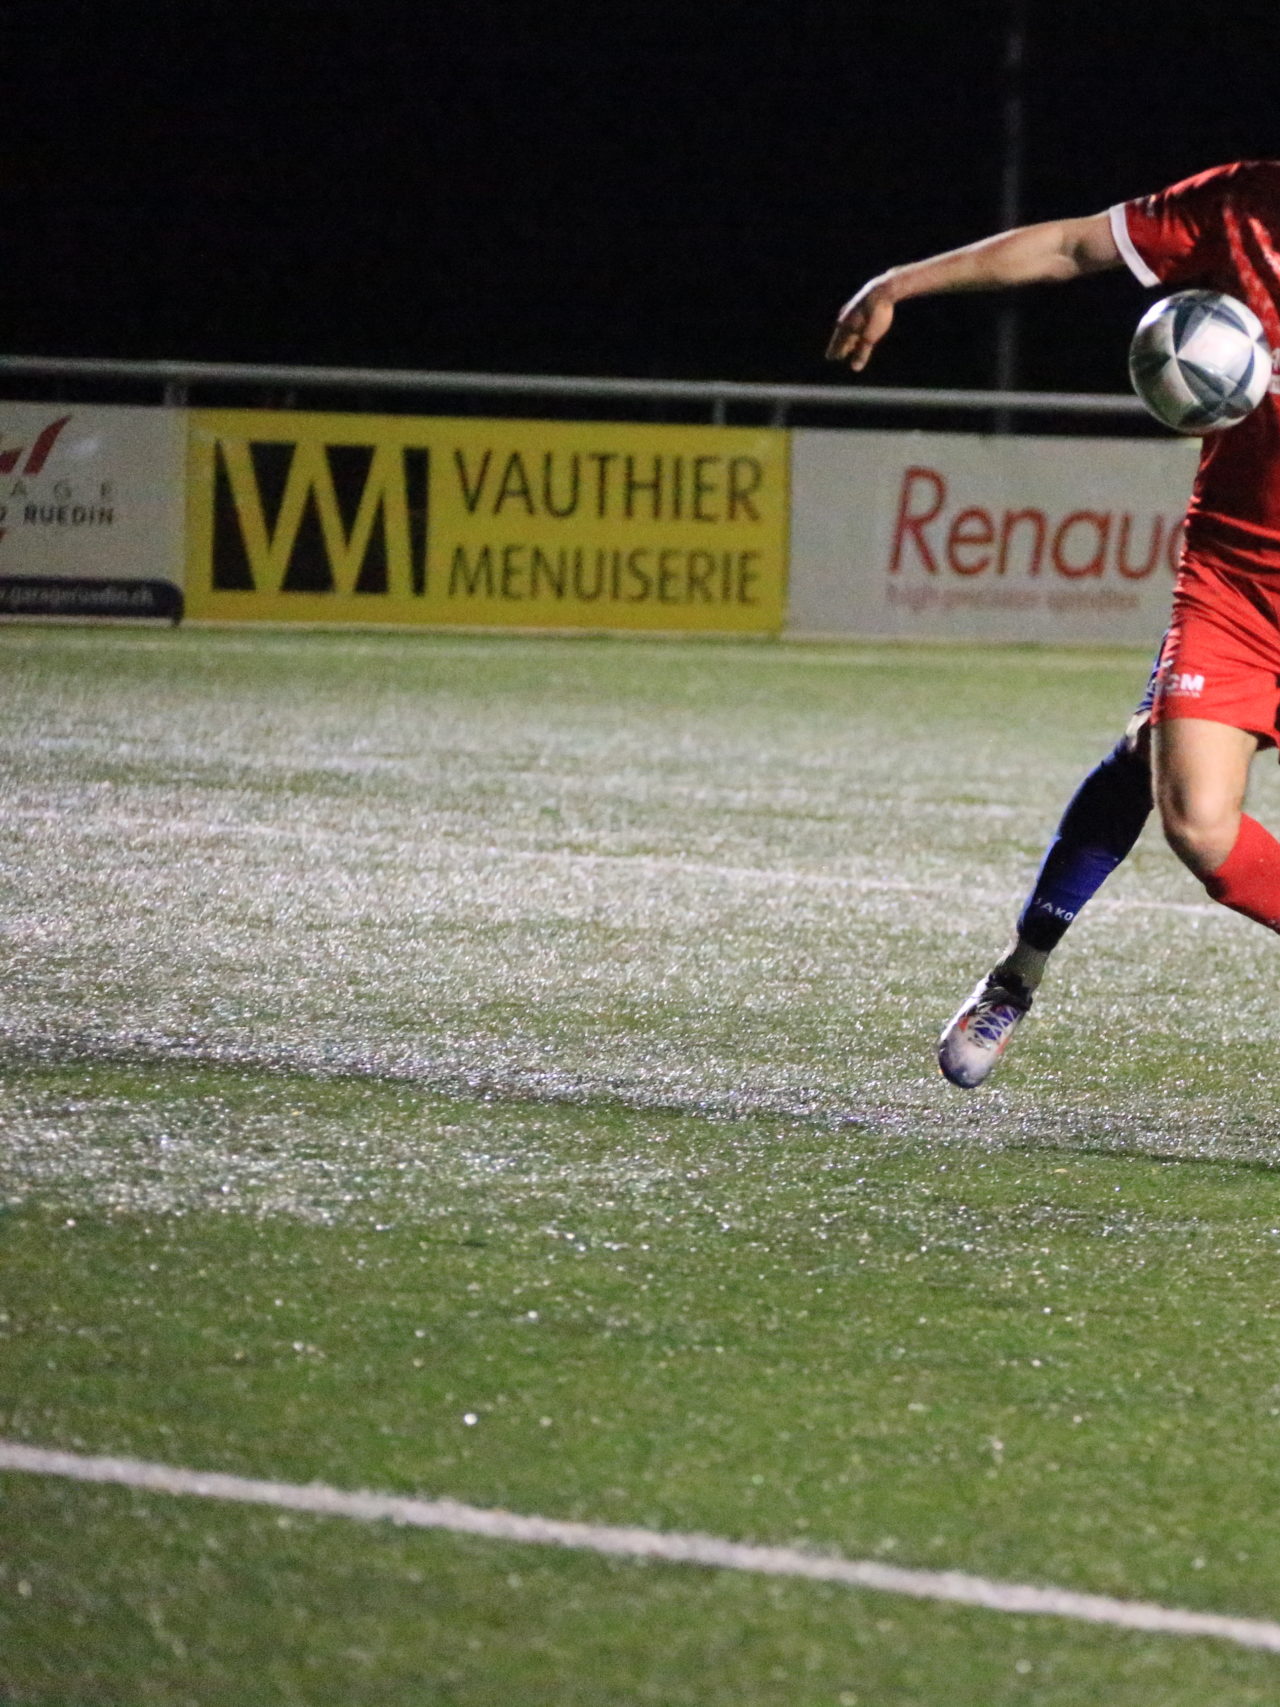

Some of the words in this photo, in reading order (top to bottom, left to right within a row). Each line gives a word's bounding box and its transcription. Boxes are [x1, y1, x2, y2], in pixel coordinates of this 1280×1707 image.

[454, 449, 764, 523] VAUTHIER
[23, 503, 115, 527] RUEDIN
[450, 544, 762, 606] MENUISERIE
[1164, 672, 1205, 692] CM
[1034, 897, 1075, 921] JAKO
